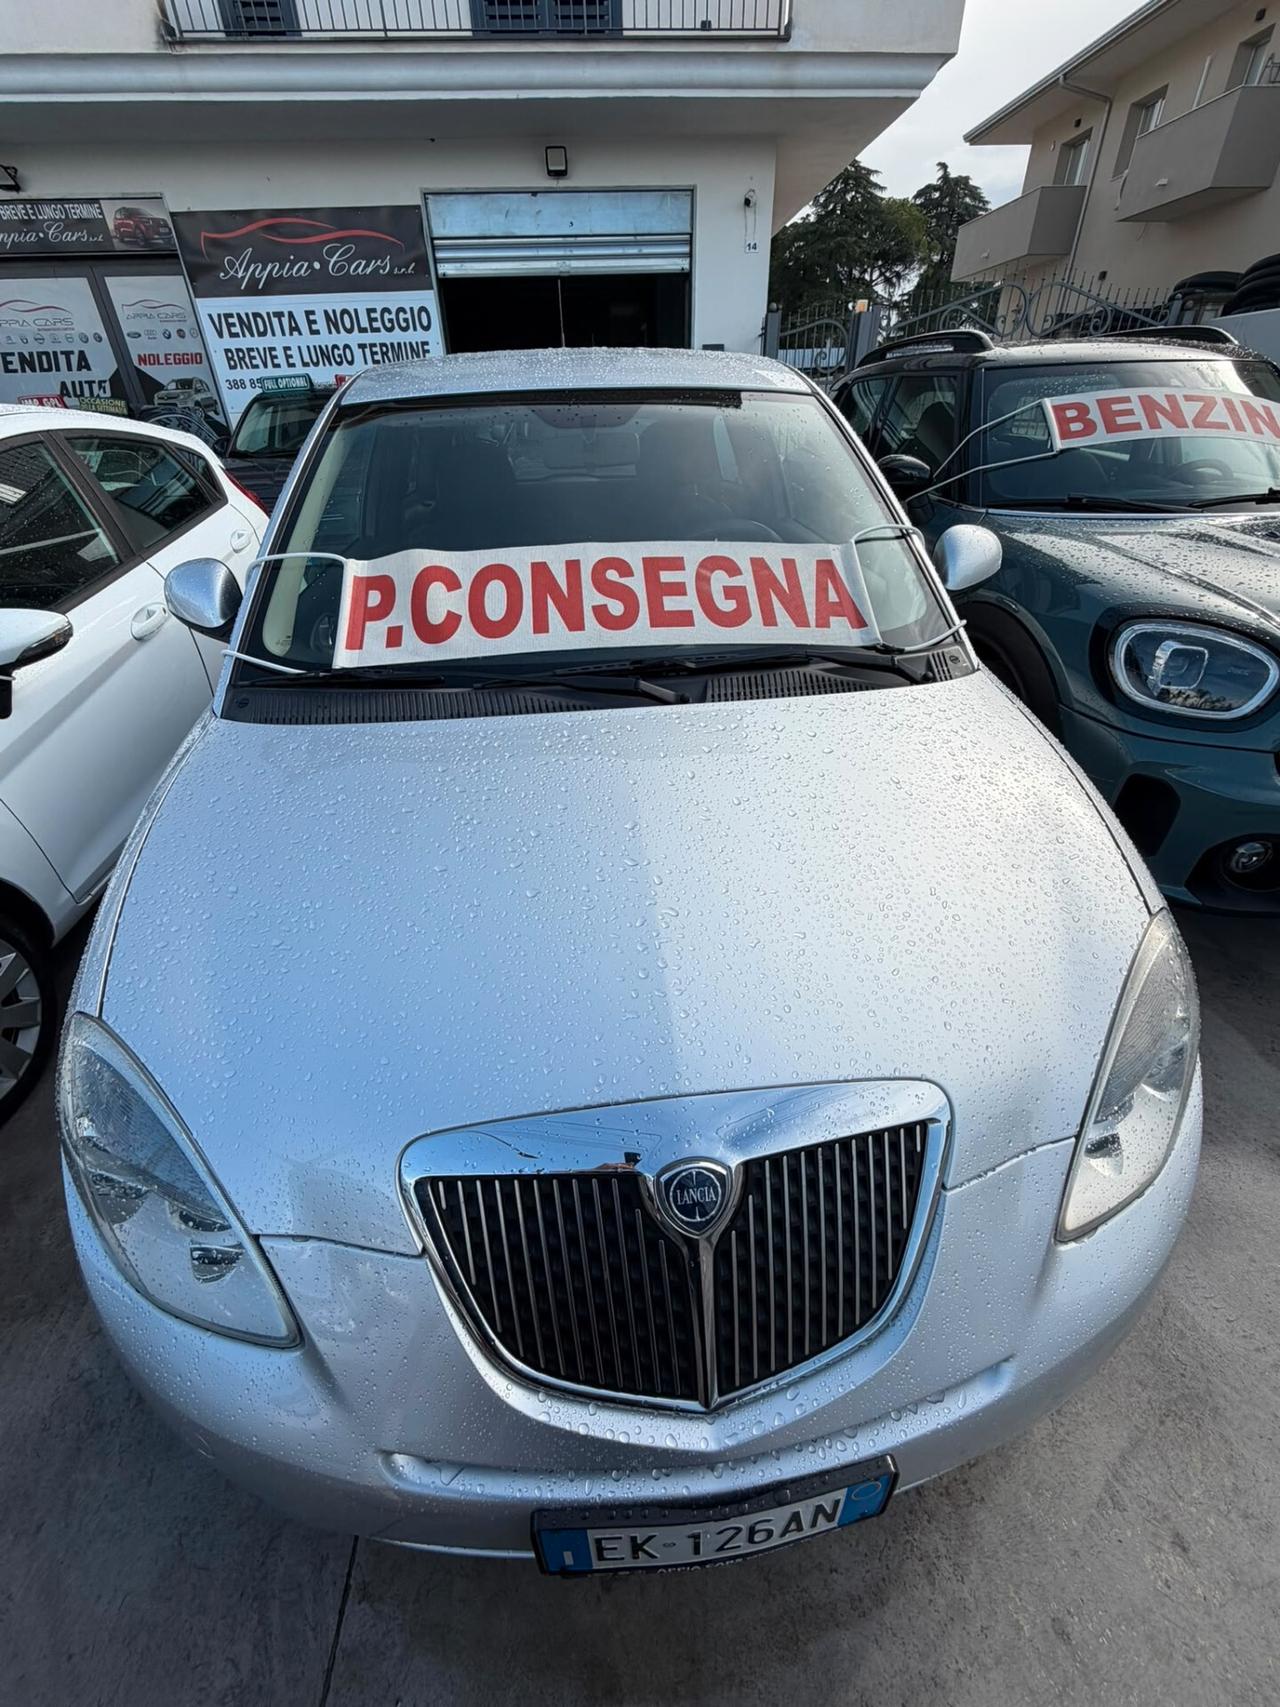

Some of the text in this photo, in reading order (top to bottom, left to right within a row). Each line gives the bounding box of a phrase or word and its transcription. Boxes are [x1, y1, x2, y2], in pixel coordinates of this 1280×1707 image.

[25, 204, 36, 219] E
[34, 204, 65, 219] LUNGO
[64, 203, 103, 219] TERMINE
[746, 242, 757, 251] 14
[219, 248, 311, 290] Appia
[322, 243, 391, 277] Cars
[33, 317, 74, 327] CARS
[208, 305, 432, 339] VENDITA E NOLEGGIO
[137, 352, 203, 366] NOLEGGIO
[224, 346, 282, 371] BREVE
[284, 345, 296, 368] E
[298, 343, 356, 369] LUNGO
[225, 378, 246, 391] 388
[264, 376, 308, 390] FULL OPTIONAL
[1052, 393, 1280, 441] BENZIN
[345, 554, 868, 651] P.CONSEGNA
[676, 1186, 716, 1205] LANCIA
[593, 1532, 660, 1563] EK
[688, 1498, 842, 1557] 126AN
